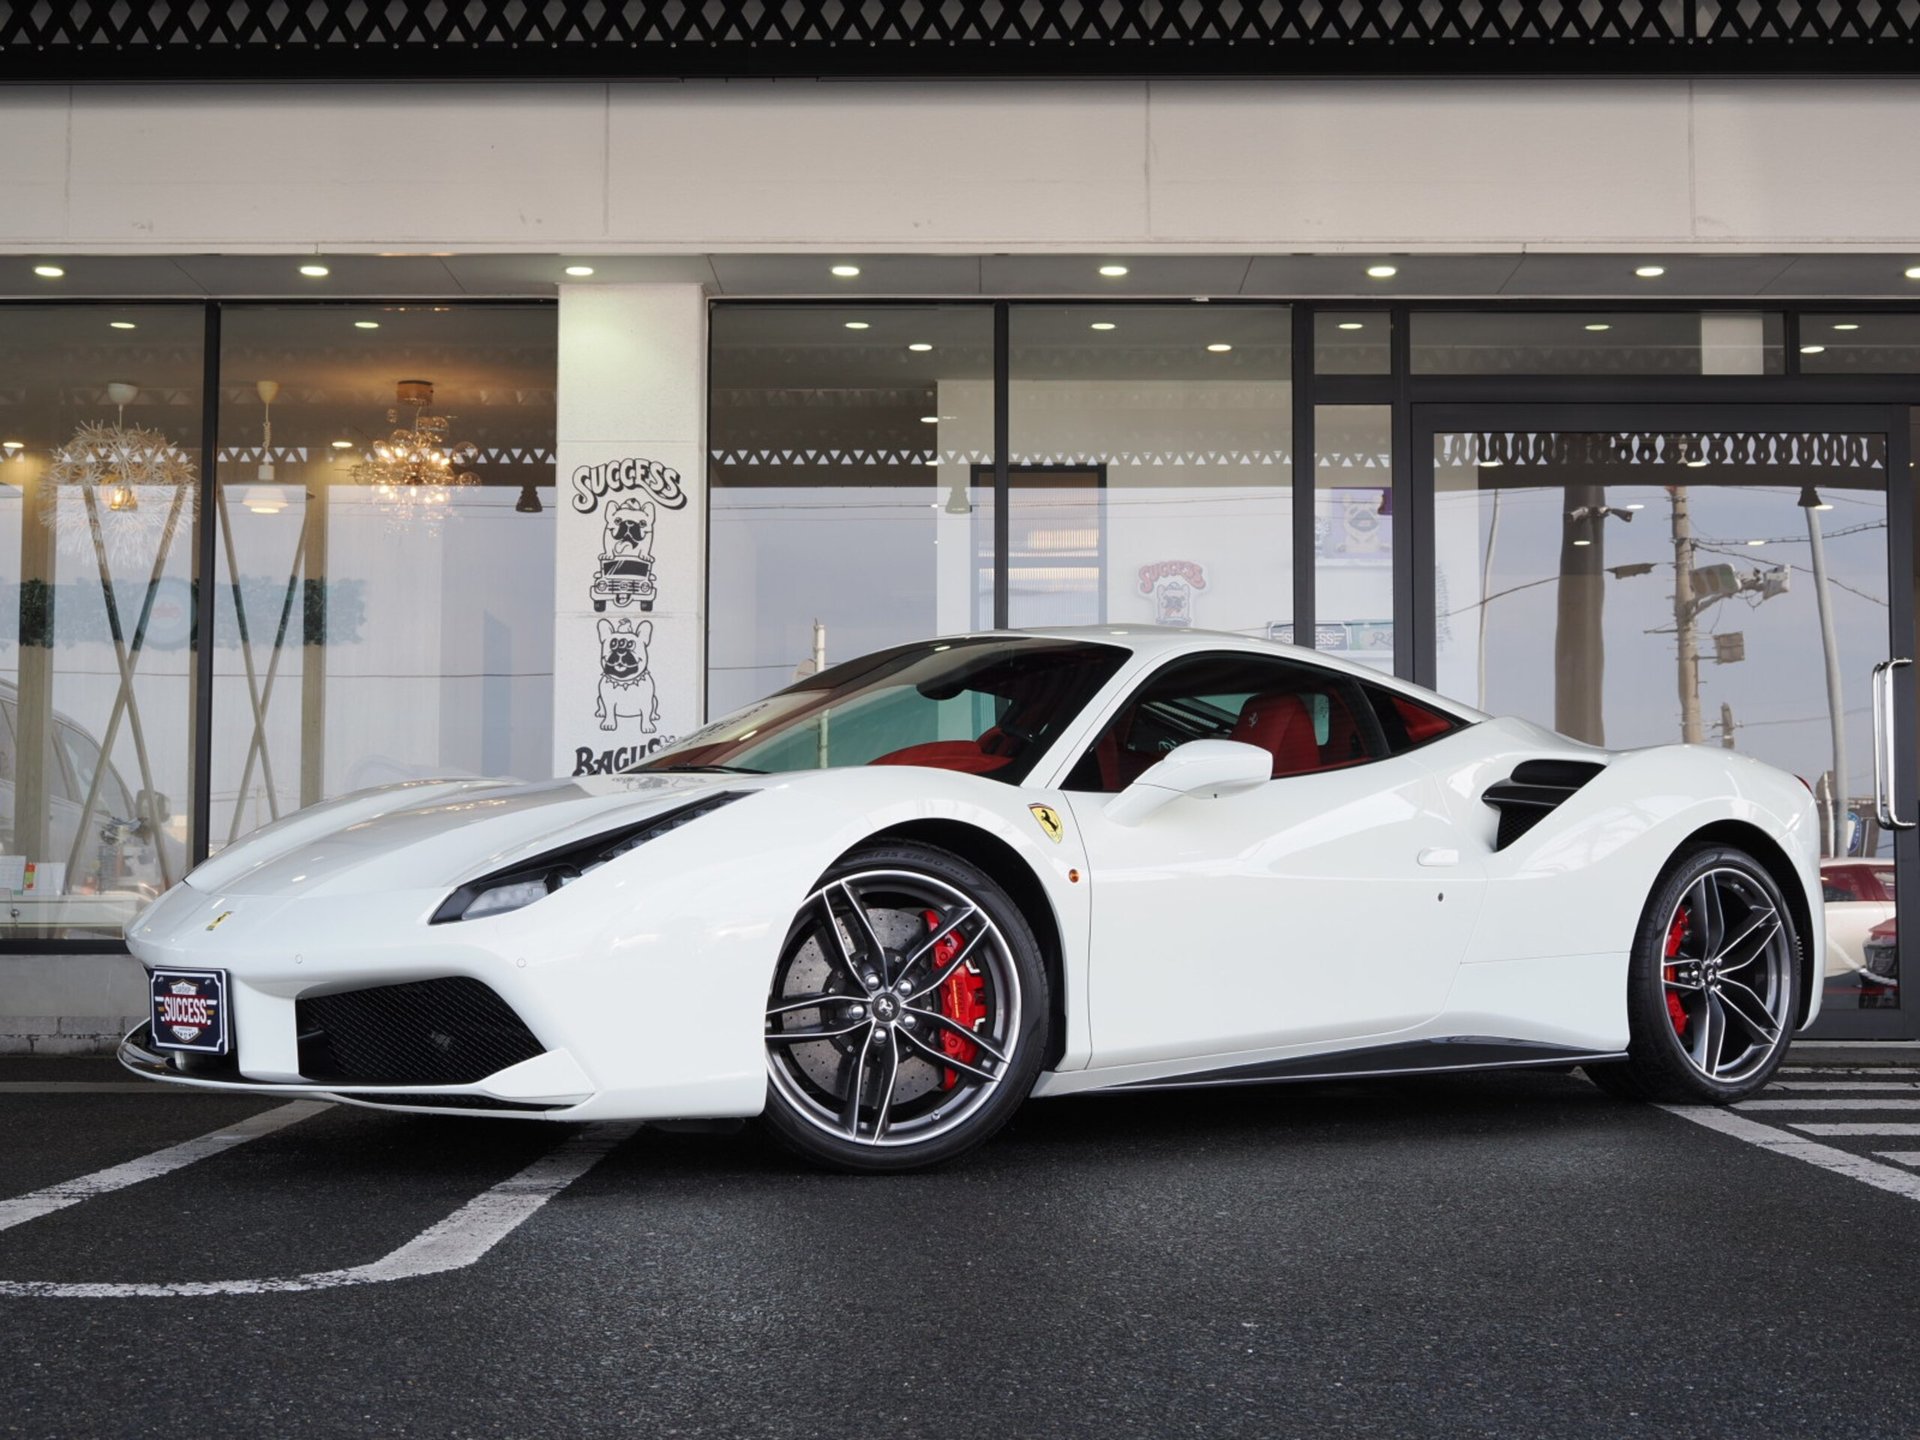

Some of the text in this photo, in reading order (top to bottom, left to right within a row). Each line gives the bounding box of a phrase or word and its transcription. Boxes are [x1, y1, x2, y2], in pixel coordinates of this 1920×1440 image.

[572, 458, 687, 514] SUCCESS
[1139, 560, 1206, 594] SUCCESS
[164, 996, 207, 1024] SUCCESS
